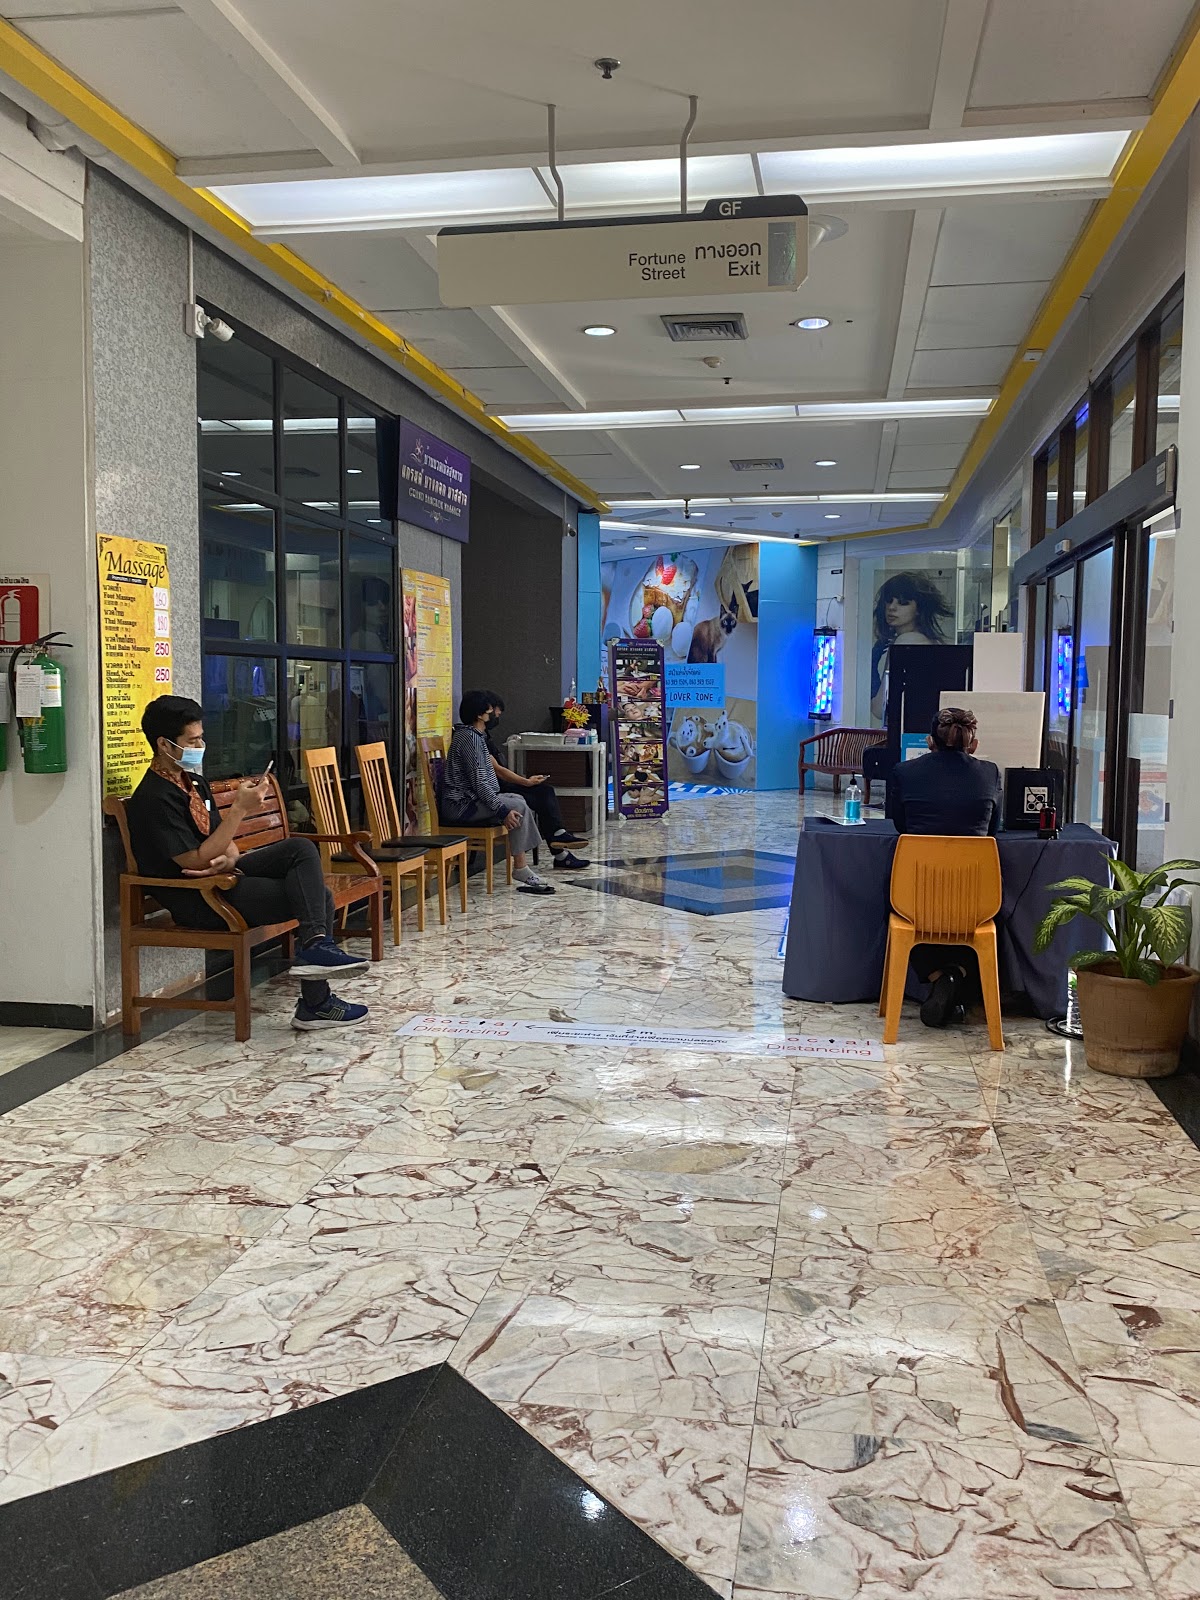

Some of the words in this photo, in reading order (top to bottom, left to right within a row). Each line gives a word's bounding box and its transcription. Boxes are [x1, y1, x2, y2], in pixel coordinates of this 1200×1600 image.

[719, 201, 742, 216] GF
[695, 242, 761, 260] ทางออก
[629, 252, 686, 267] Fortune
[641, 267, 686, 281] Street
[728, 261, 761, 277] Exit
[105, 551, 165, 588] Massage
[116, 593, 136, 602] Massage
[117, 619, 137, 627] Massage
[132, 645, 151, 653] Massage
[155, 643, 170, 656] 250
[155, 668, 170, 681] 250
[670, 692, 691, 702] LOVER
[695, 692, 713, 702] ZONE
[413, 1025, 510, 1036] Distancing
[766, 1043, 872, 1056] Distancing
